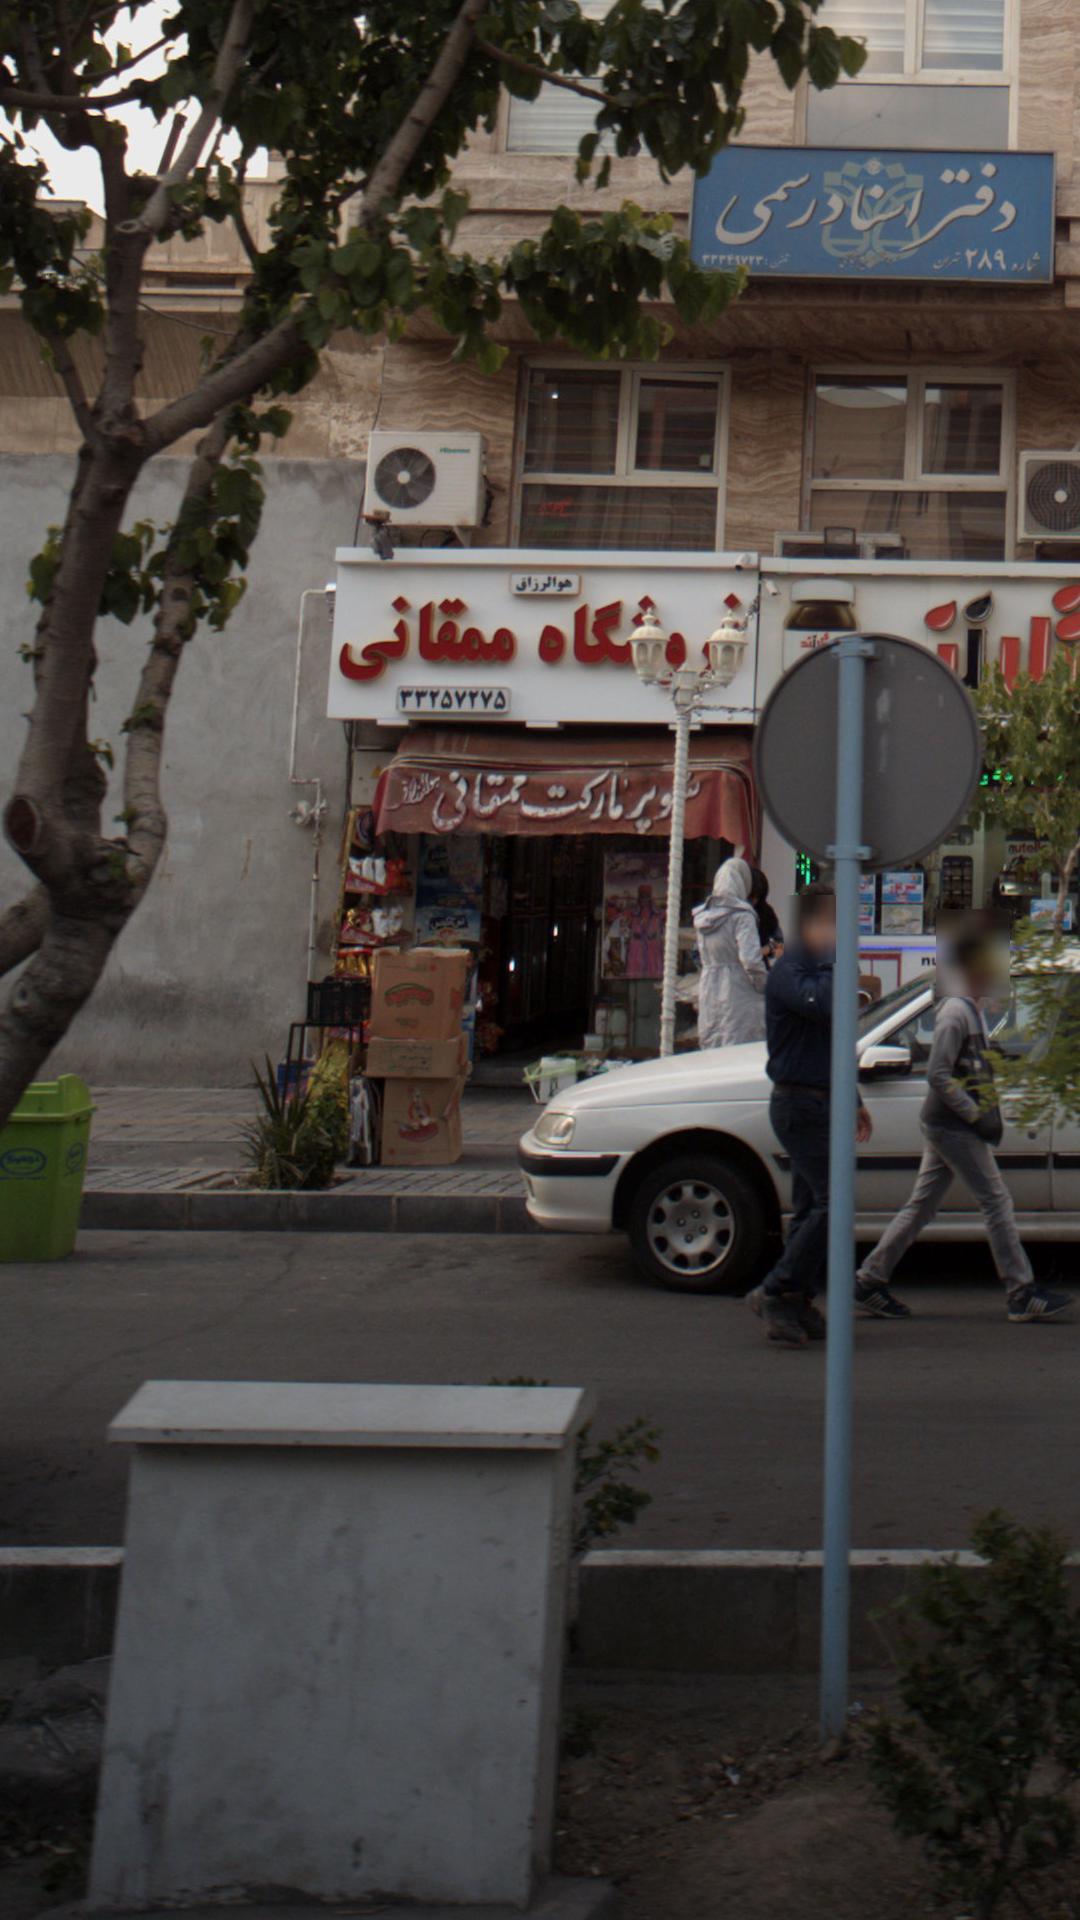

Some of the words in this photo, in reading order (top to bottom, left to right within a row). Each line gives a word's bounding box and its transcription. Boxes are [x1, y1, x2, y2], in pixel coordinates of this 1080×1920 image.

[714, 172, 818, 247] رسمی
[818, 183, 924, 232] اسناد
[900, 161, 1018, 253] دفتر
[515, 575, 573, 592] هوالرزاق
[339, 595, 518, 682] ممقانی
[537, 592, 742, 686] وگاه
[400, 689, 506, 710] ۳۳۲۵۷۲۷۵
[431, 769, 527, 832] ممقانی
[520, 769, 623, 819] مارکت
